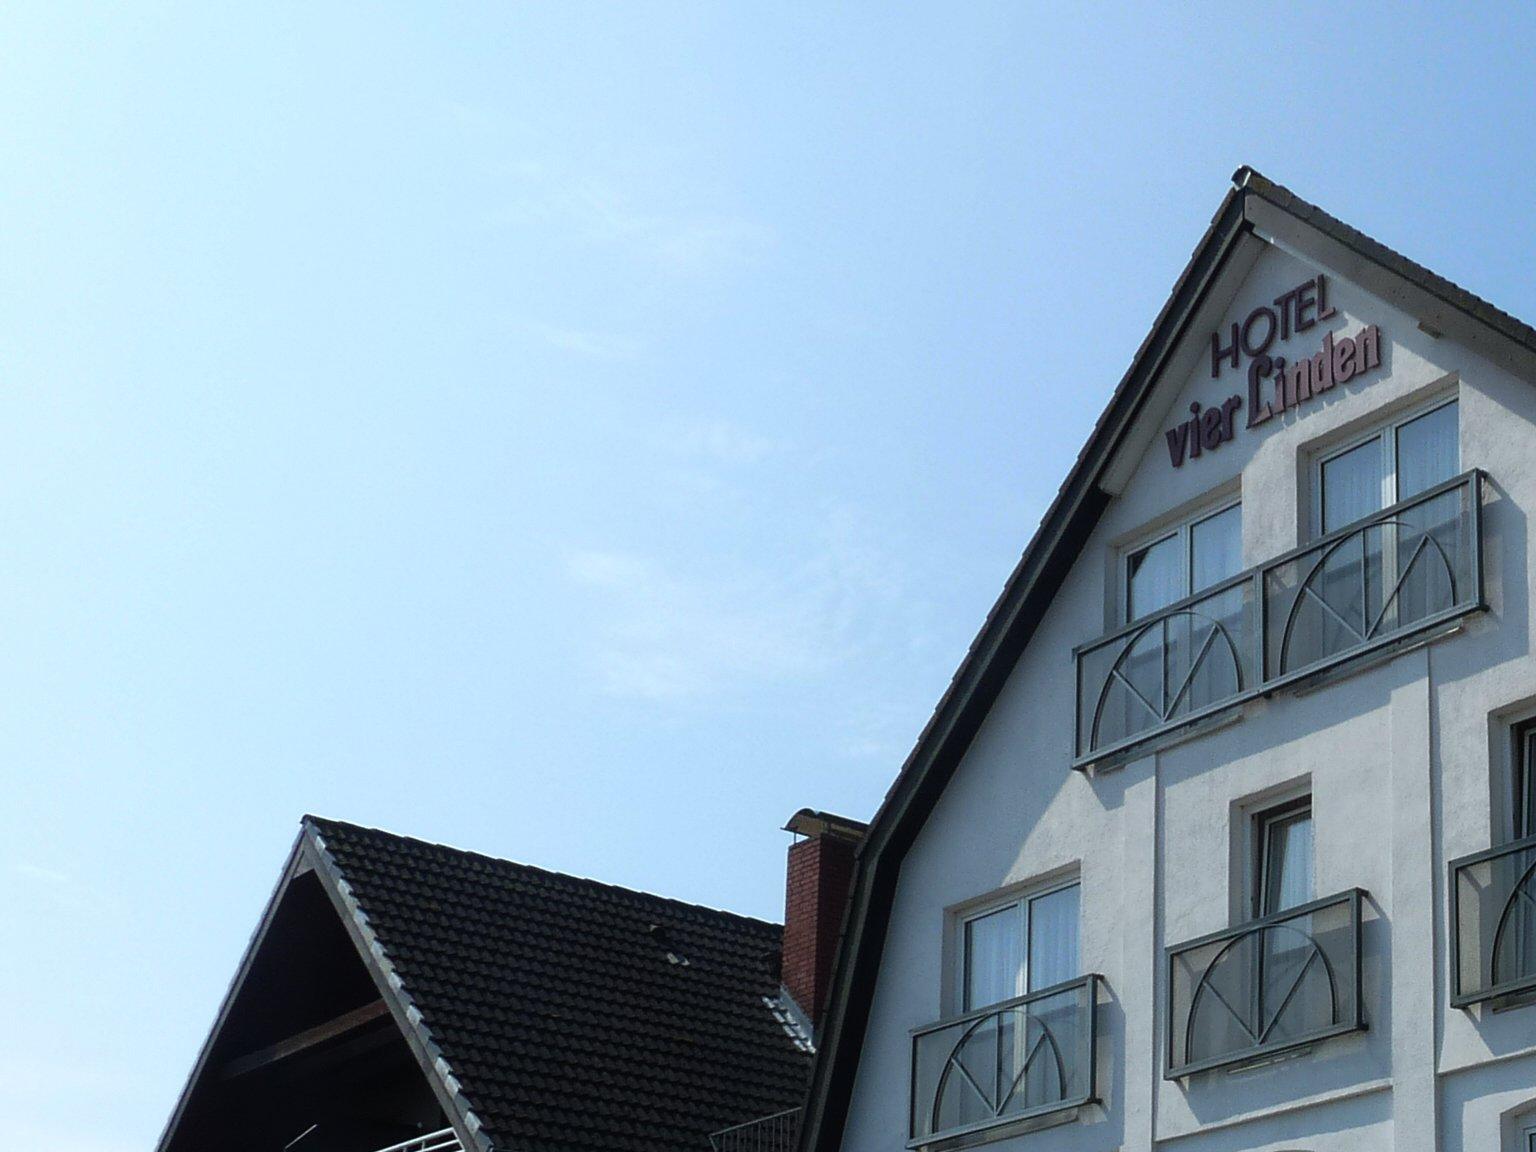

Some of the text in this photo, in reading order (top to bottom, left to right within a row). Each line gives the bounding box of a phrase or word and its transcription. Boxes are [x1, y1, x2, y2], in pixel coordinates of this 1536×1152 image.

[1211, 273, 1336, 378] HOTEL
[1165, 323, 1381, 468] vier Linden
